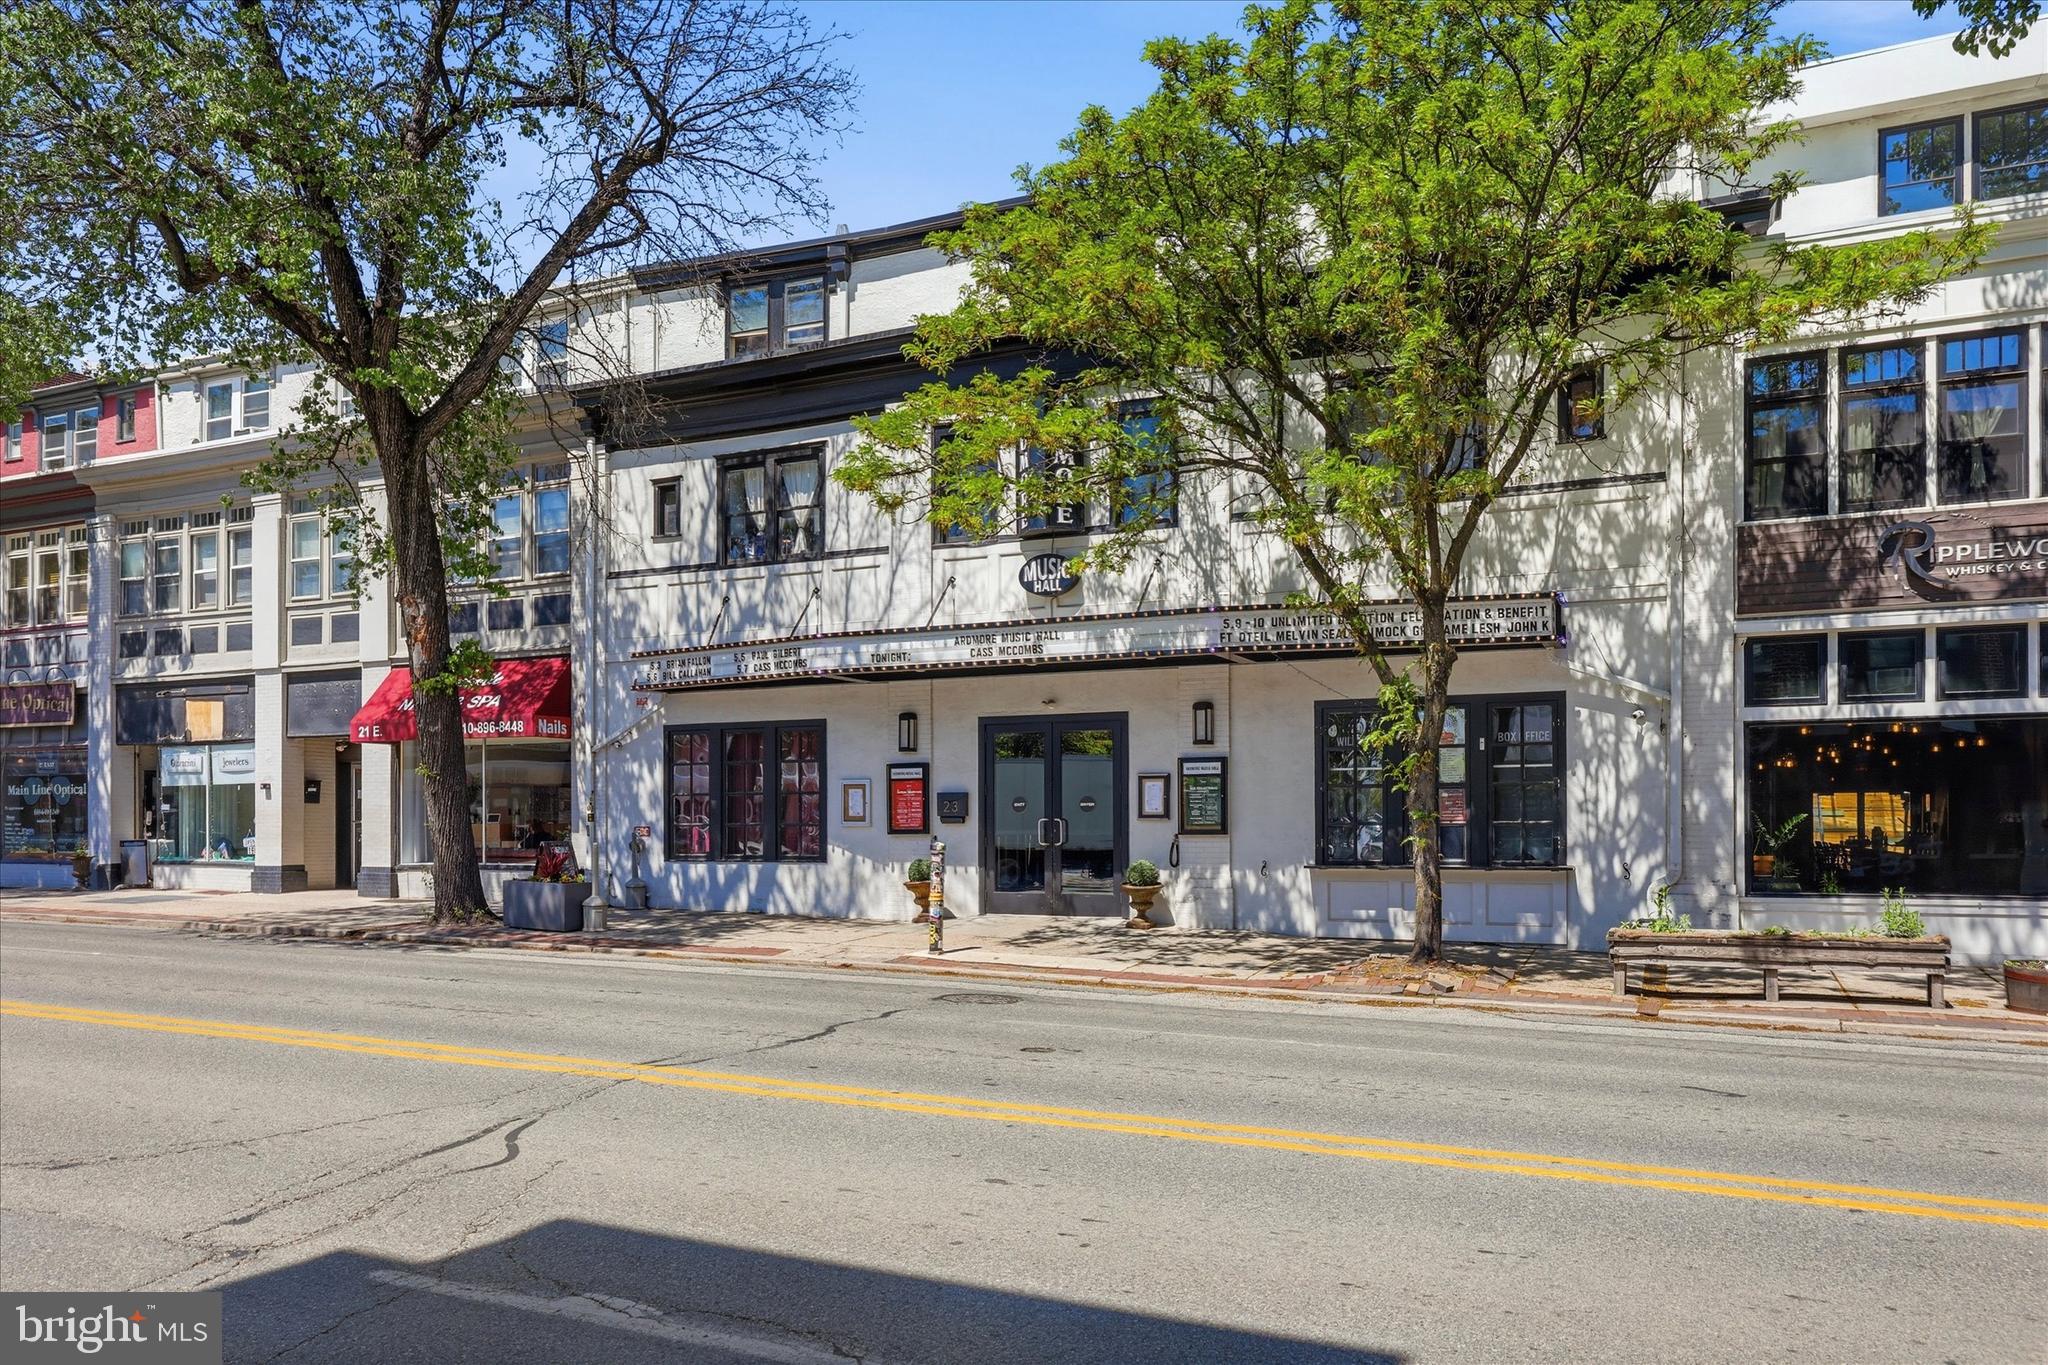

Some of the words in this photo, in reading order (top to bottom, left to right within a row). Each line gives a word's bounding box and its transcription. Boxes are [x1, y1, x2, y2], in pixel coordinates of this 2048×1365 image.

[1023, 557, 1071, 582] MUSIC
[1946, 563, 2014, 576] WHISKEY
[2019, 561, 2031, 571] &
[1033, 580, 1062, 593] HALL
[1272, 615, 1333, 627] UNLIMITED
[1401, 608, 1480, 622] CELATION
[1484, 608, 1493, 619] &
[1498, 606, 1547, 619] BENEFIT
[954, 633, 997, 646] ARDMORE
[1002, 632, 1031, 643] MUSIC
[1036, 630, 1060, 642] HALL
[1220, 632, 1233, 643] FT
[1239, 632, 1271, 643] OTEIL
[1276, 630, 1318, 642] MELVIN
[1322, 628, 1350, 639] SEAL
[1472, 623, 1500, 635] LESH
[1507, 621, 1538, 633] JOHN
[1542, 620, 1549, 631] K
[970, 647, 993, 659] CASS
[999, 645, 1044, 657] MCCOMBS
[754, 662, 771, 673] CASS
[22, 693, 70, 714] Optical
[467, 695, 501, 708] SPA
[358, 726, 370, 738] 21
[373, 726, 382, 737] E.
[463, 720, 524, 734] 10-896-8448
[538, 719, 568, 734] Nails
[1497, 732, 1517, 742] BOX
[1518, 730, 1550, 741] FFICE
[8, 784, 29, 796] Main
[32, 784, 52, 795] Line
[54, 783, 87, 798] Optical
[943, 800, 959, 813] 23
